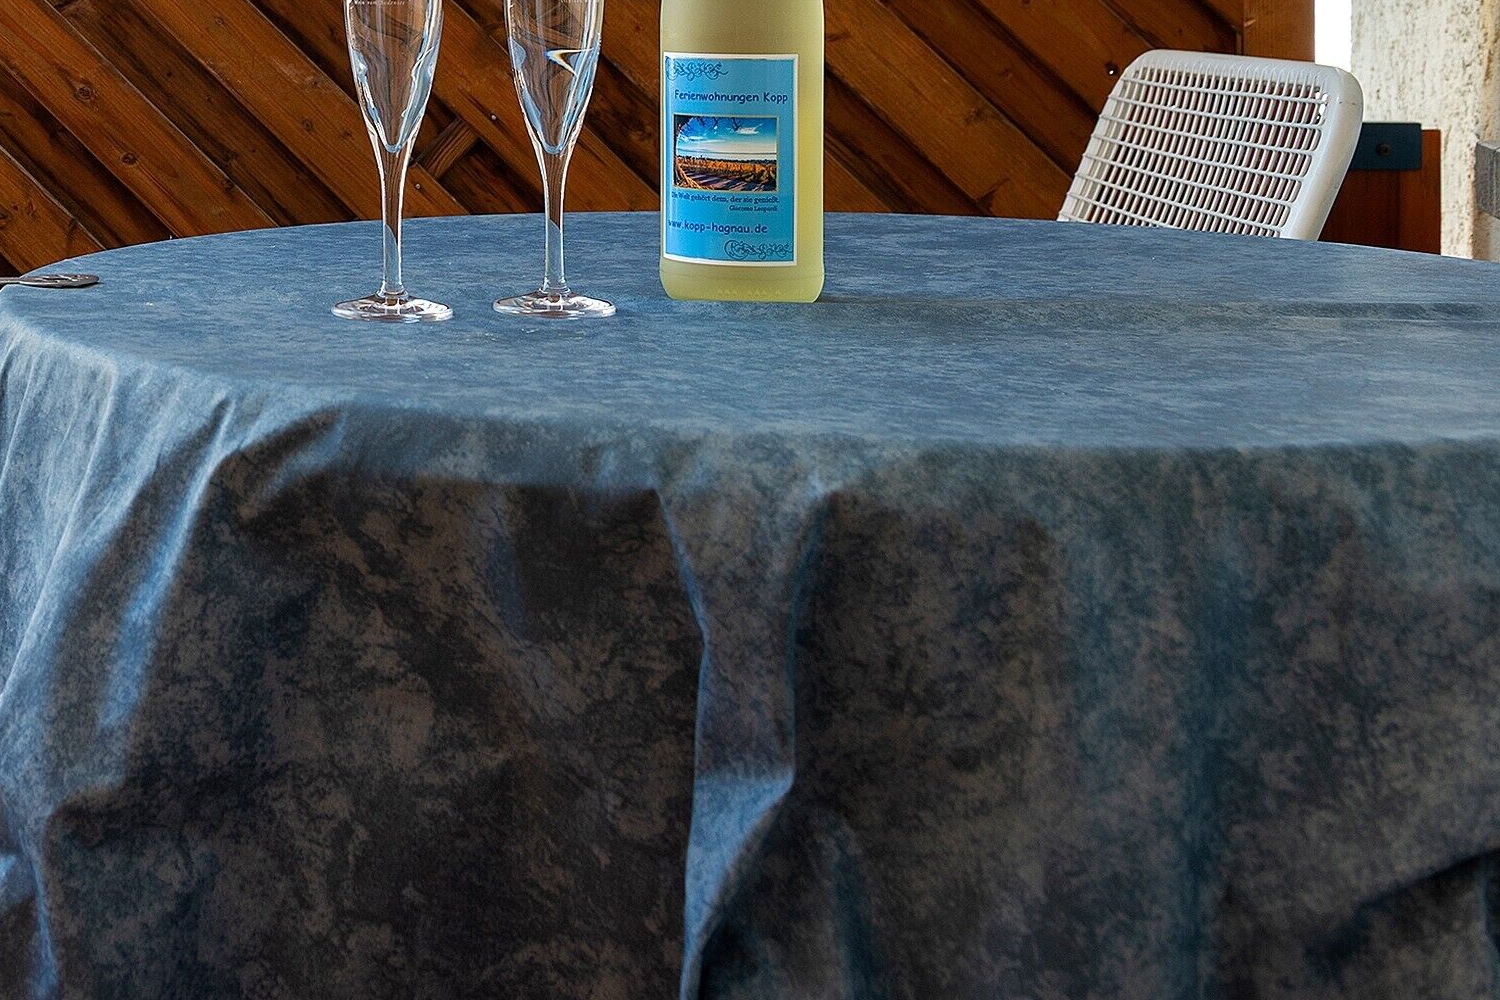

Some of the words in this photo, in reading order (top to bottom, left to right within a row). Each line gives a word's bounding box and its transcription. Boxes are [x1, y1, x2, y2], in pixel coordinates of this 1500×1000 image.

[674, 89, 759, 104] Ferienwohnungen
[763, 91, 788, 104] Kopp
[679, 191, 690, 199] Welt
[691, 193, 711, 202] gehört
[730, 195, 742, 203] der
[754, 205, 778, 213] Leopardi
[668, 219, 768, 235] www.kopp-hagnau.de
